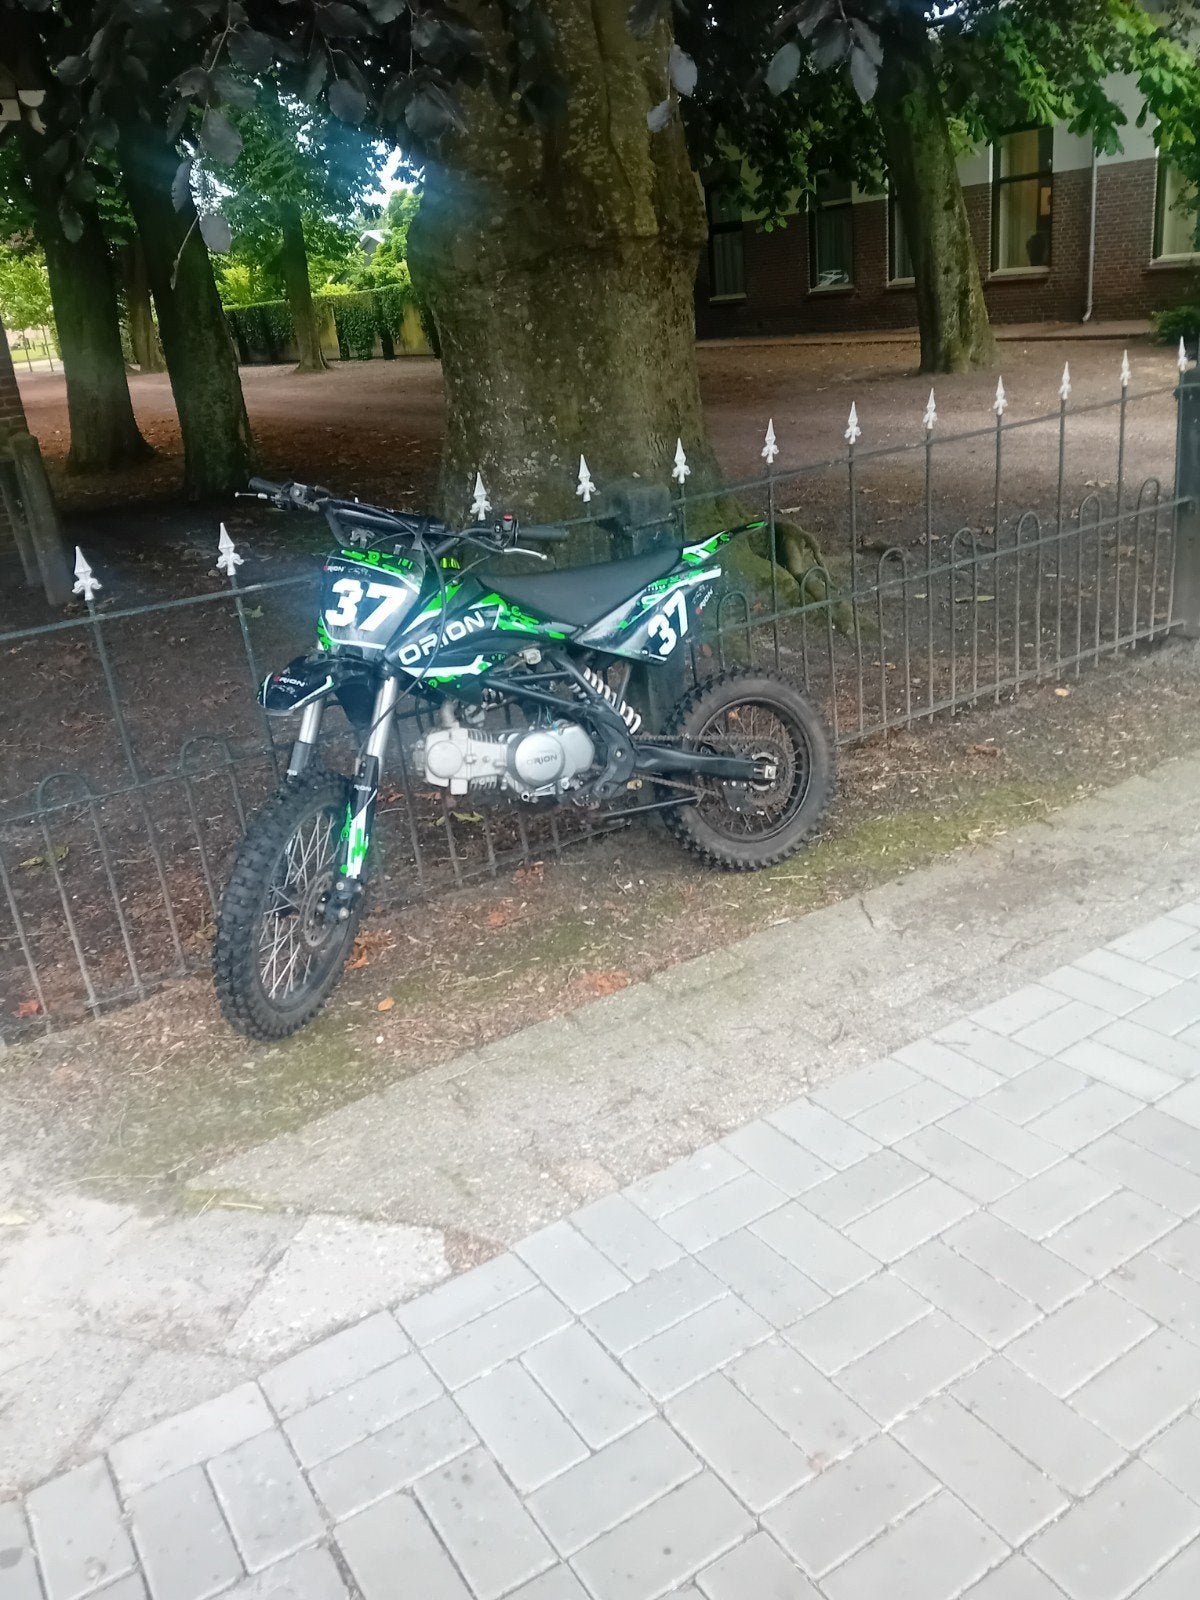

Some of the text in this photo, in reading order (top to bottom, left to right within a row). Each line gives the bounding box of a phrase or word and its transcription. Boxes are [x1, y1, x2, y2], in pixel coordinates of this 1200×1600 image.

[325, 578, 408, 632] 37
[647, 589, 689, 656] 37
[398, 611, 486, 666] ORION
[526, 754, 558, 765] ORION
